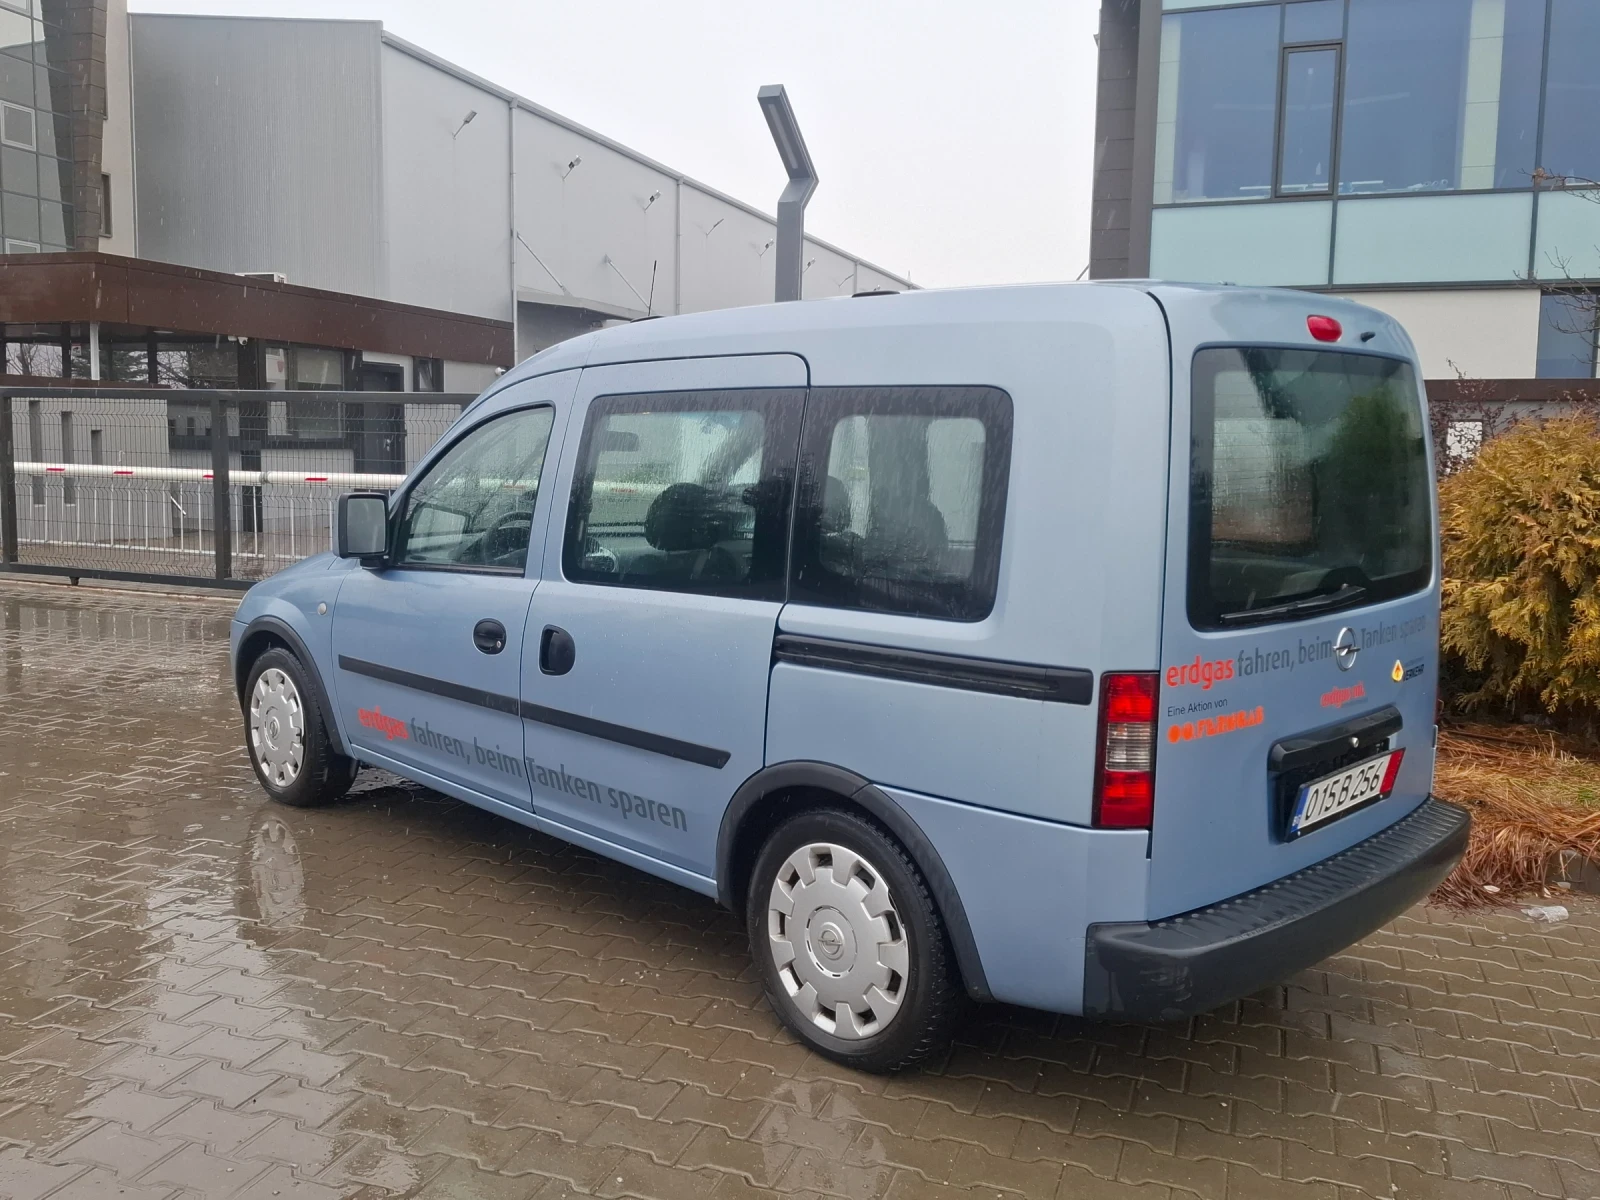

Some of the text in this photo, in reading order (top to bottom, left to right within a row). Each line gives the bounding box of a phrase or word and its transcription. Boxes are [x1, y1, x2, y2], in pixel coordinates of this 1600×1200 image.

[1166, 655, 1234, 690] erdgas
[1237, 649, 1295, 677] fahren,
[1298, 635, 1333, 665] beim
[1361, 621, 1397, 650] Tanken
[1167, 698, 1228, 717] Eine Aktion von
[357, 705, 688, 833] erdgas fahren, beim Tanken sparen
